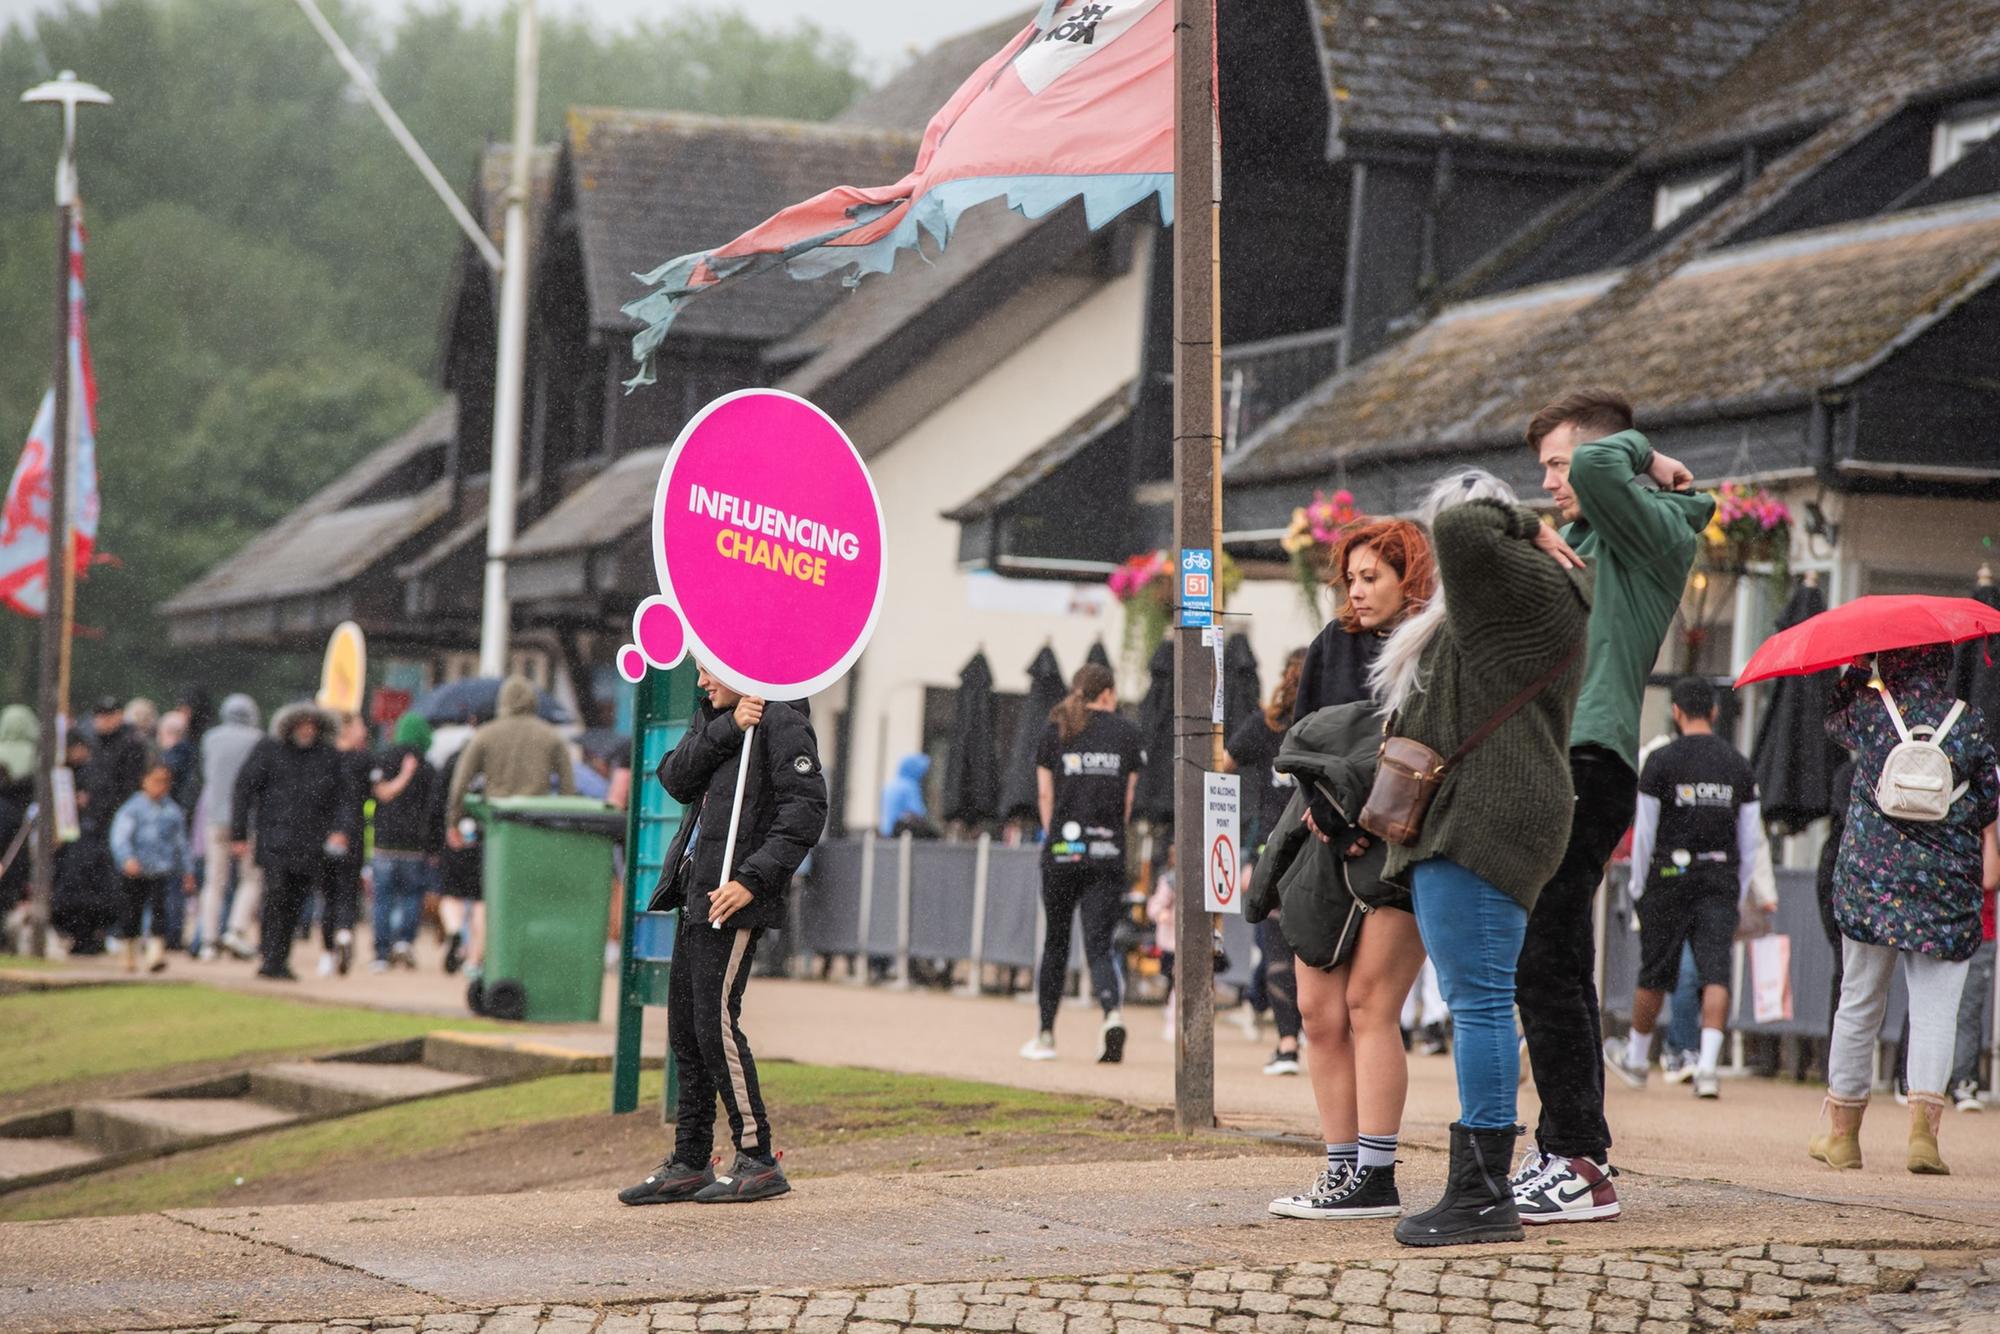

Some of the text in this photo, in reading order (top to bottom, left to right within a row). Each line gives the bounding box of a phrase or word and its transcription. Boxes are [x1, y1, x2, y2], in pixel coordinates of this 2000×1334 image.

[688, 483, 860, 561] INFLUENCING
[716, 529, 828, 587] CHANGE
[1189, 578, 1205, 592] 51
[1082, 752, 1120, 768] OPUS
[1209, 785, 1237, 797] NO ALCOHOL
[1695, 782, 1733, 799] OPUS
[1209, 802, 1237, 813] BEYOND THIS
[1216, 818, 1230, 828] POINT
